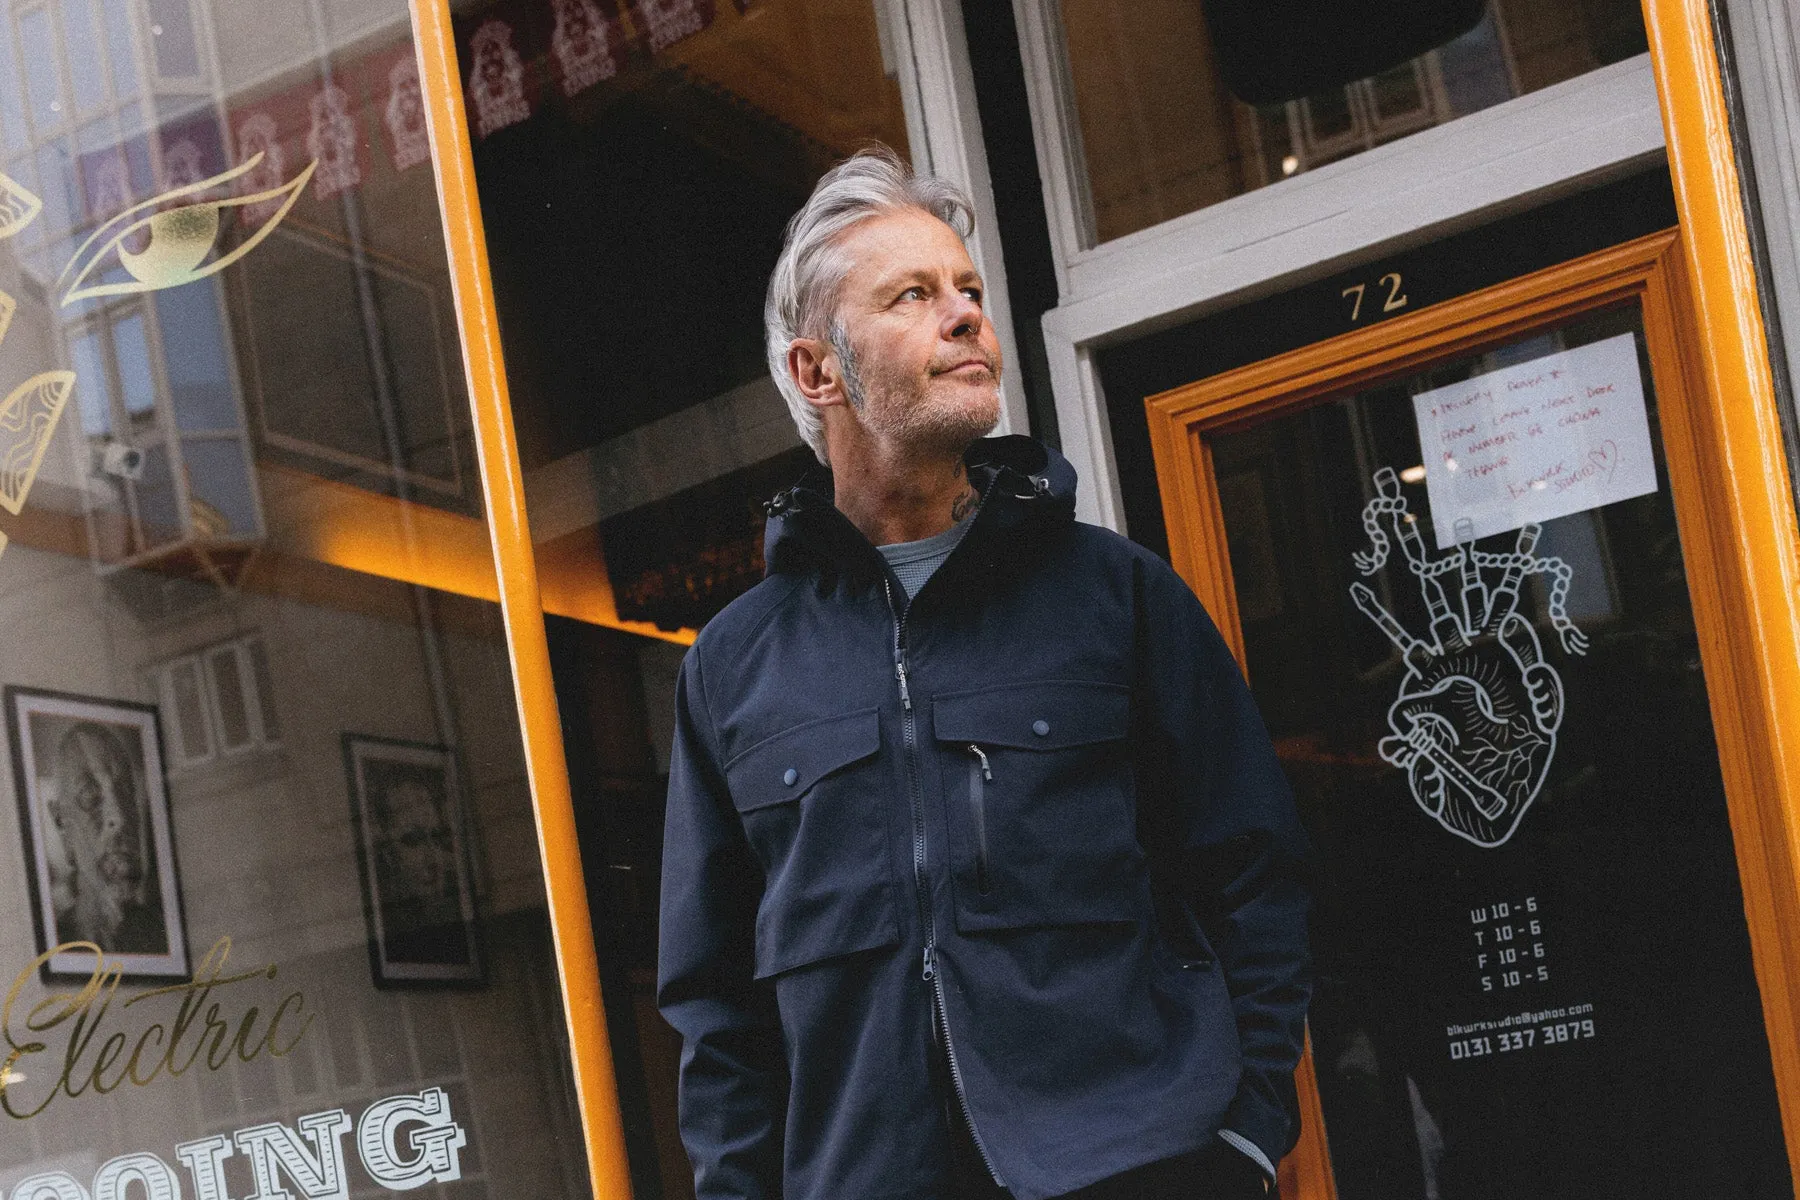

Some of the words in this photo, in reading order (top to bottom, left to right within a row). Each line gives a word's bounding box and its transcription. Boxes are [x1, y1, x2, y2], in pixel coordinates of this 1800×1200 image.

[1342, 272, 1408, 321] 72
[1470, 907, 1487, 924] W
[1474, 931, 1484, 946] T
[1477, 953, 1488, 969] F
[1481, 975, 1493, 991] S
[0, 936, 318, 1120] Electric
[1450, 1036, 1493, 1060] 0131
[1497, 1029, 1535, 1052] 337
[1541, 1019, 1596, 1045] 3879
